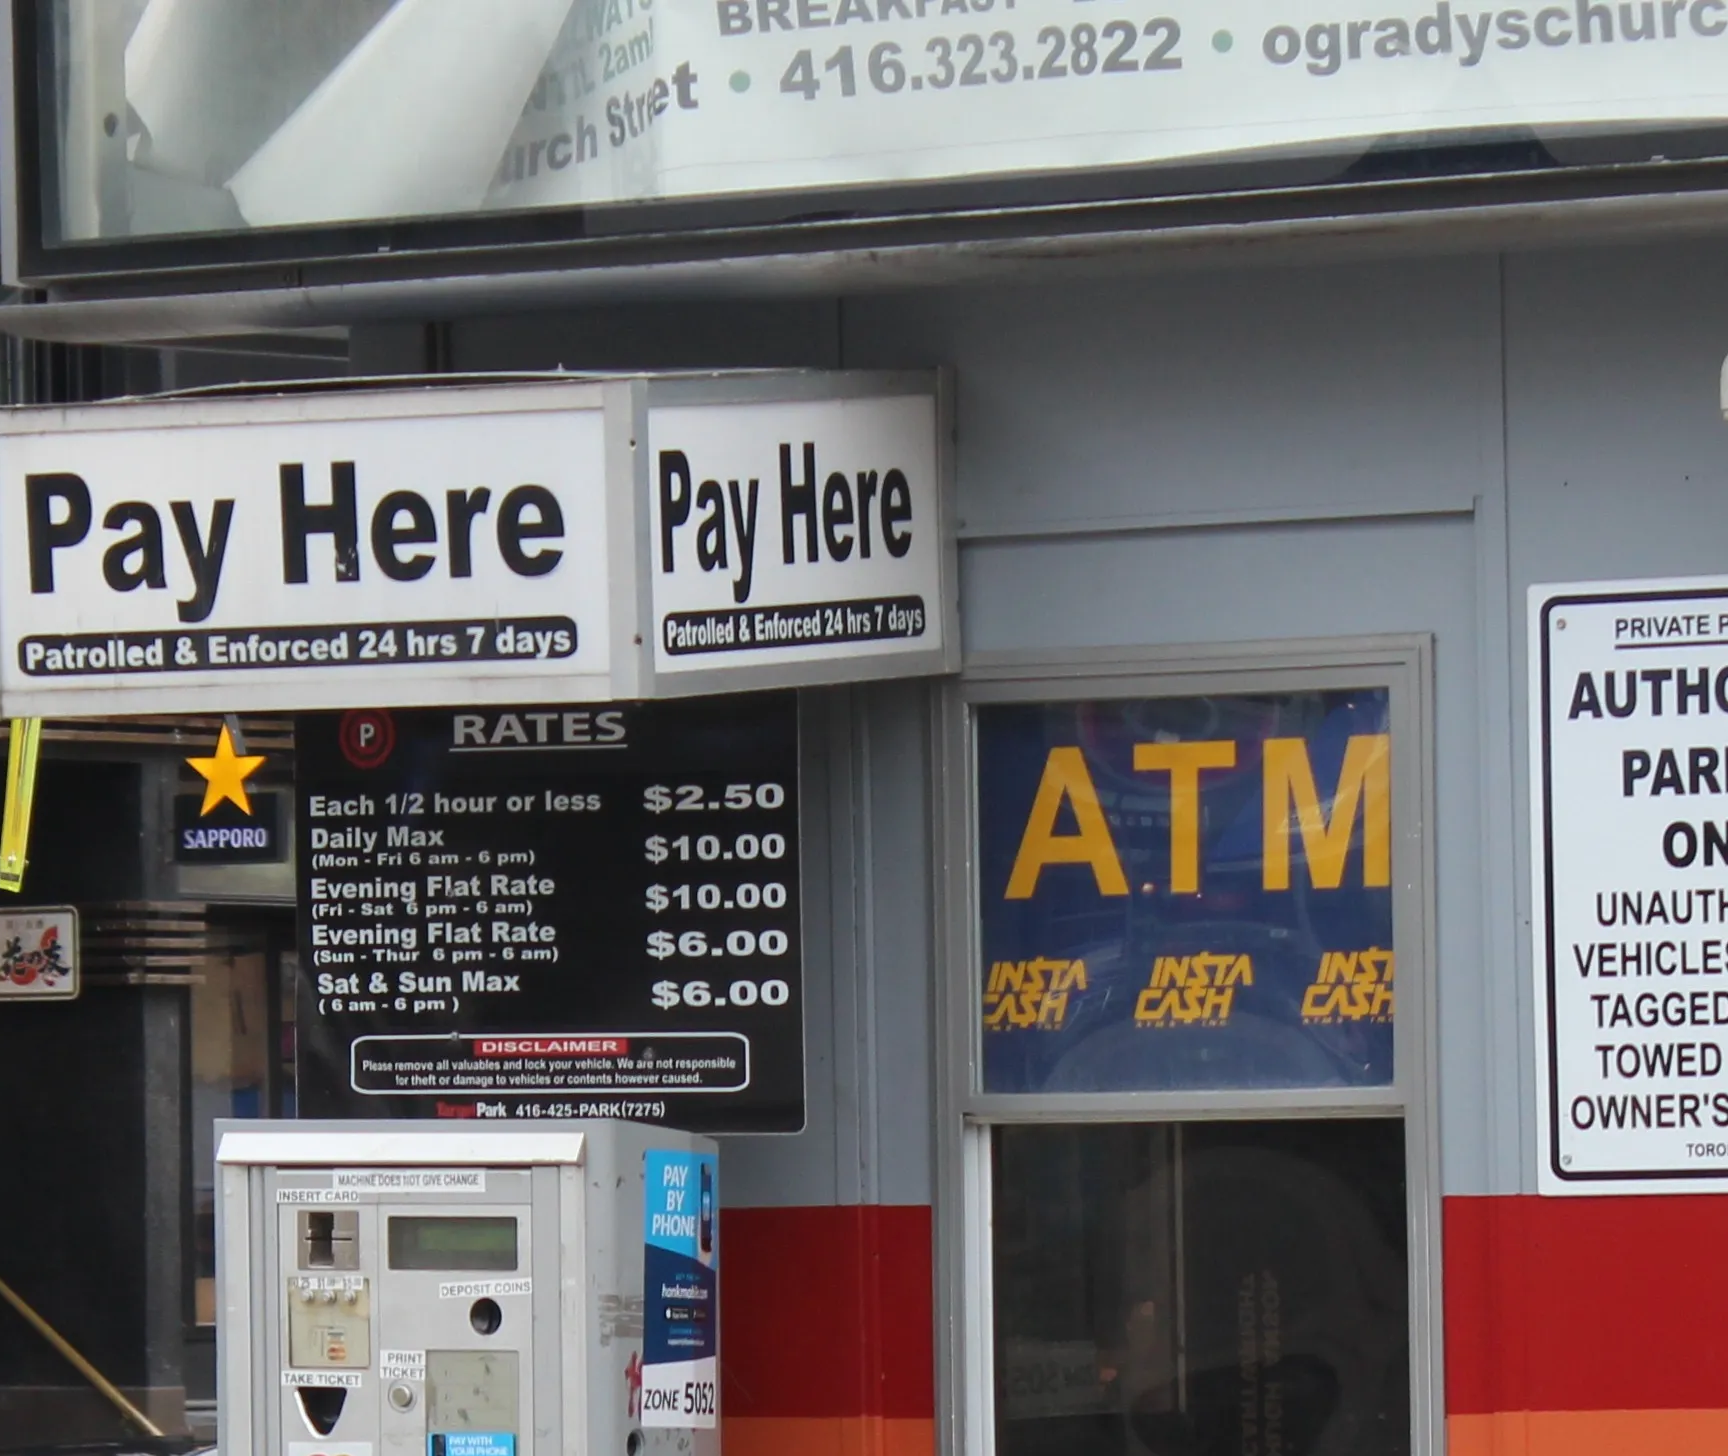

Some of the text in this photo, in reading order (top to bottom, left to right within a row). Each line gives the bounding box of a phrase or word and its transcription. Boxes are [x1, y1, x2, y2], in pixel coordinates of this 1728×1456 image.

[500, 115, 598, 184] urch
[780, 17, 1183, 100] 416.323.2822
[660, 442, 912, 603] Pay Here
[25, 461, 564, 622] Pay Here
[667, 603, 923, 647] Patrolled & Enforced 24 hrs 7 days
[1614, 613, 1712, 639] PRIVATE
[26, 625, 571, 670] Patrolled & Enforced 24 hrs 7 days
[453, 711, 627, 744] RATES
[310, 783, 784, 817] Each 1/2 hour or less $2.50
[1004, 734, 1390, 899] ATM
[183, 827, 268, 850] SAPPORO
[311, 826, 785, 864] Daily Max $10.00
[311, 875, 786, 913] Evening Flat Rate $10.00
[312, 921, 788, 960] Evening Flat Rate $6.00
[318, 971, 789, 1010] Sat & Sun Max $6.00
[482, 1040, 617, 1053] DISCLAIMER
[1595, 1042, 1722, 1078] TOWED
[362, 1056, 736, 1072] Please remove all valuables and lock your vehicle. We are not responsible
[515, 1101, 665, 1118] 416-425-PARK(7275)
[279, 1190, 359, 1201] INSERT CARD
[338, 1174, 479, 1186] MACHINE DOES NOT GIVE CHANGE
[441, 1281, 531, 1296] DEPOSIT COINS
[382, 1367, 424, 1378] TICKET
[387, 1352, 423, 1363] PRINT
[284, 1373, 360, 1385] TAKE TICKET
[644, 1382, 714, 1414] ZONE 5052
